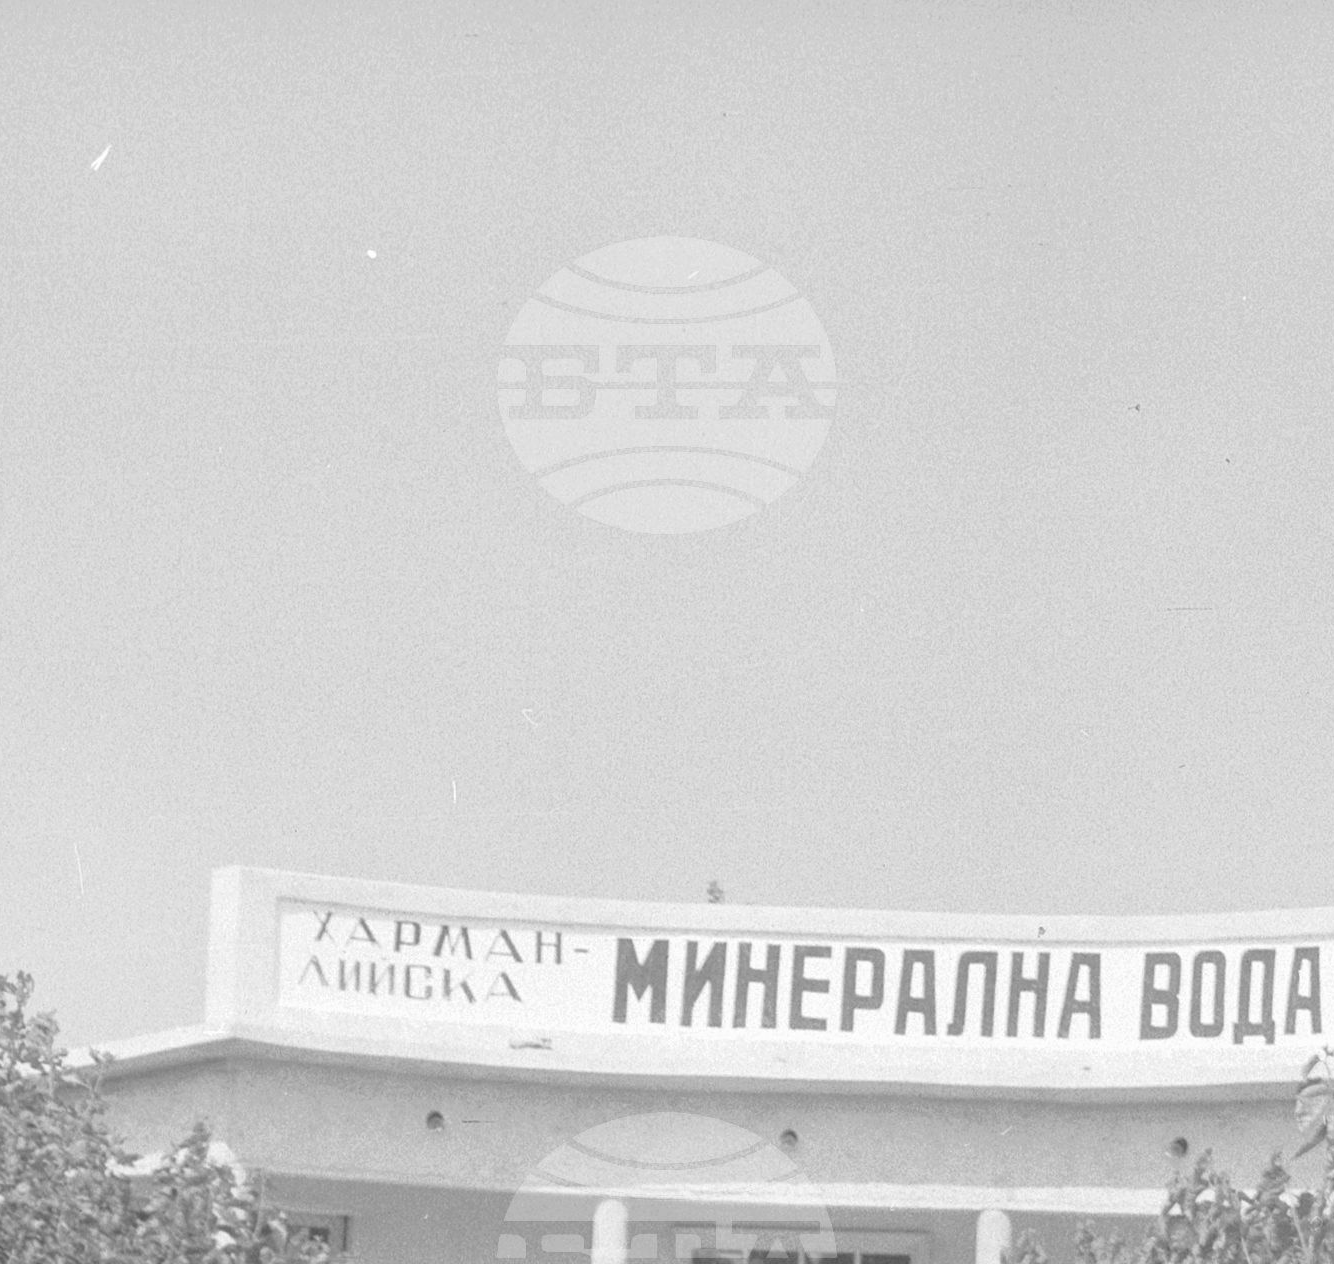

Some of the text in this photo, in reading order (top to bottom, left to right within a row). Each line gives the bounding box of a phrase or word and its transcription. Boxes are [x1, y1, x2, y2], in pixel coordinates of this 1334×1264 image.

[312, 911, 588, 965] ХАРМАН-
[612, 938, 1324, 1045] МИНЕРАЛНА ВОДА
